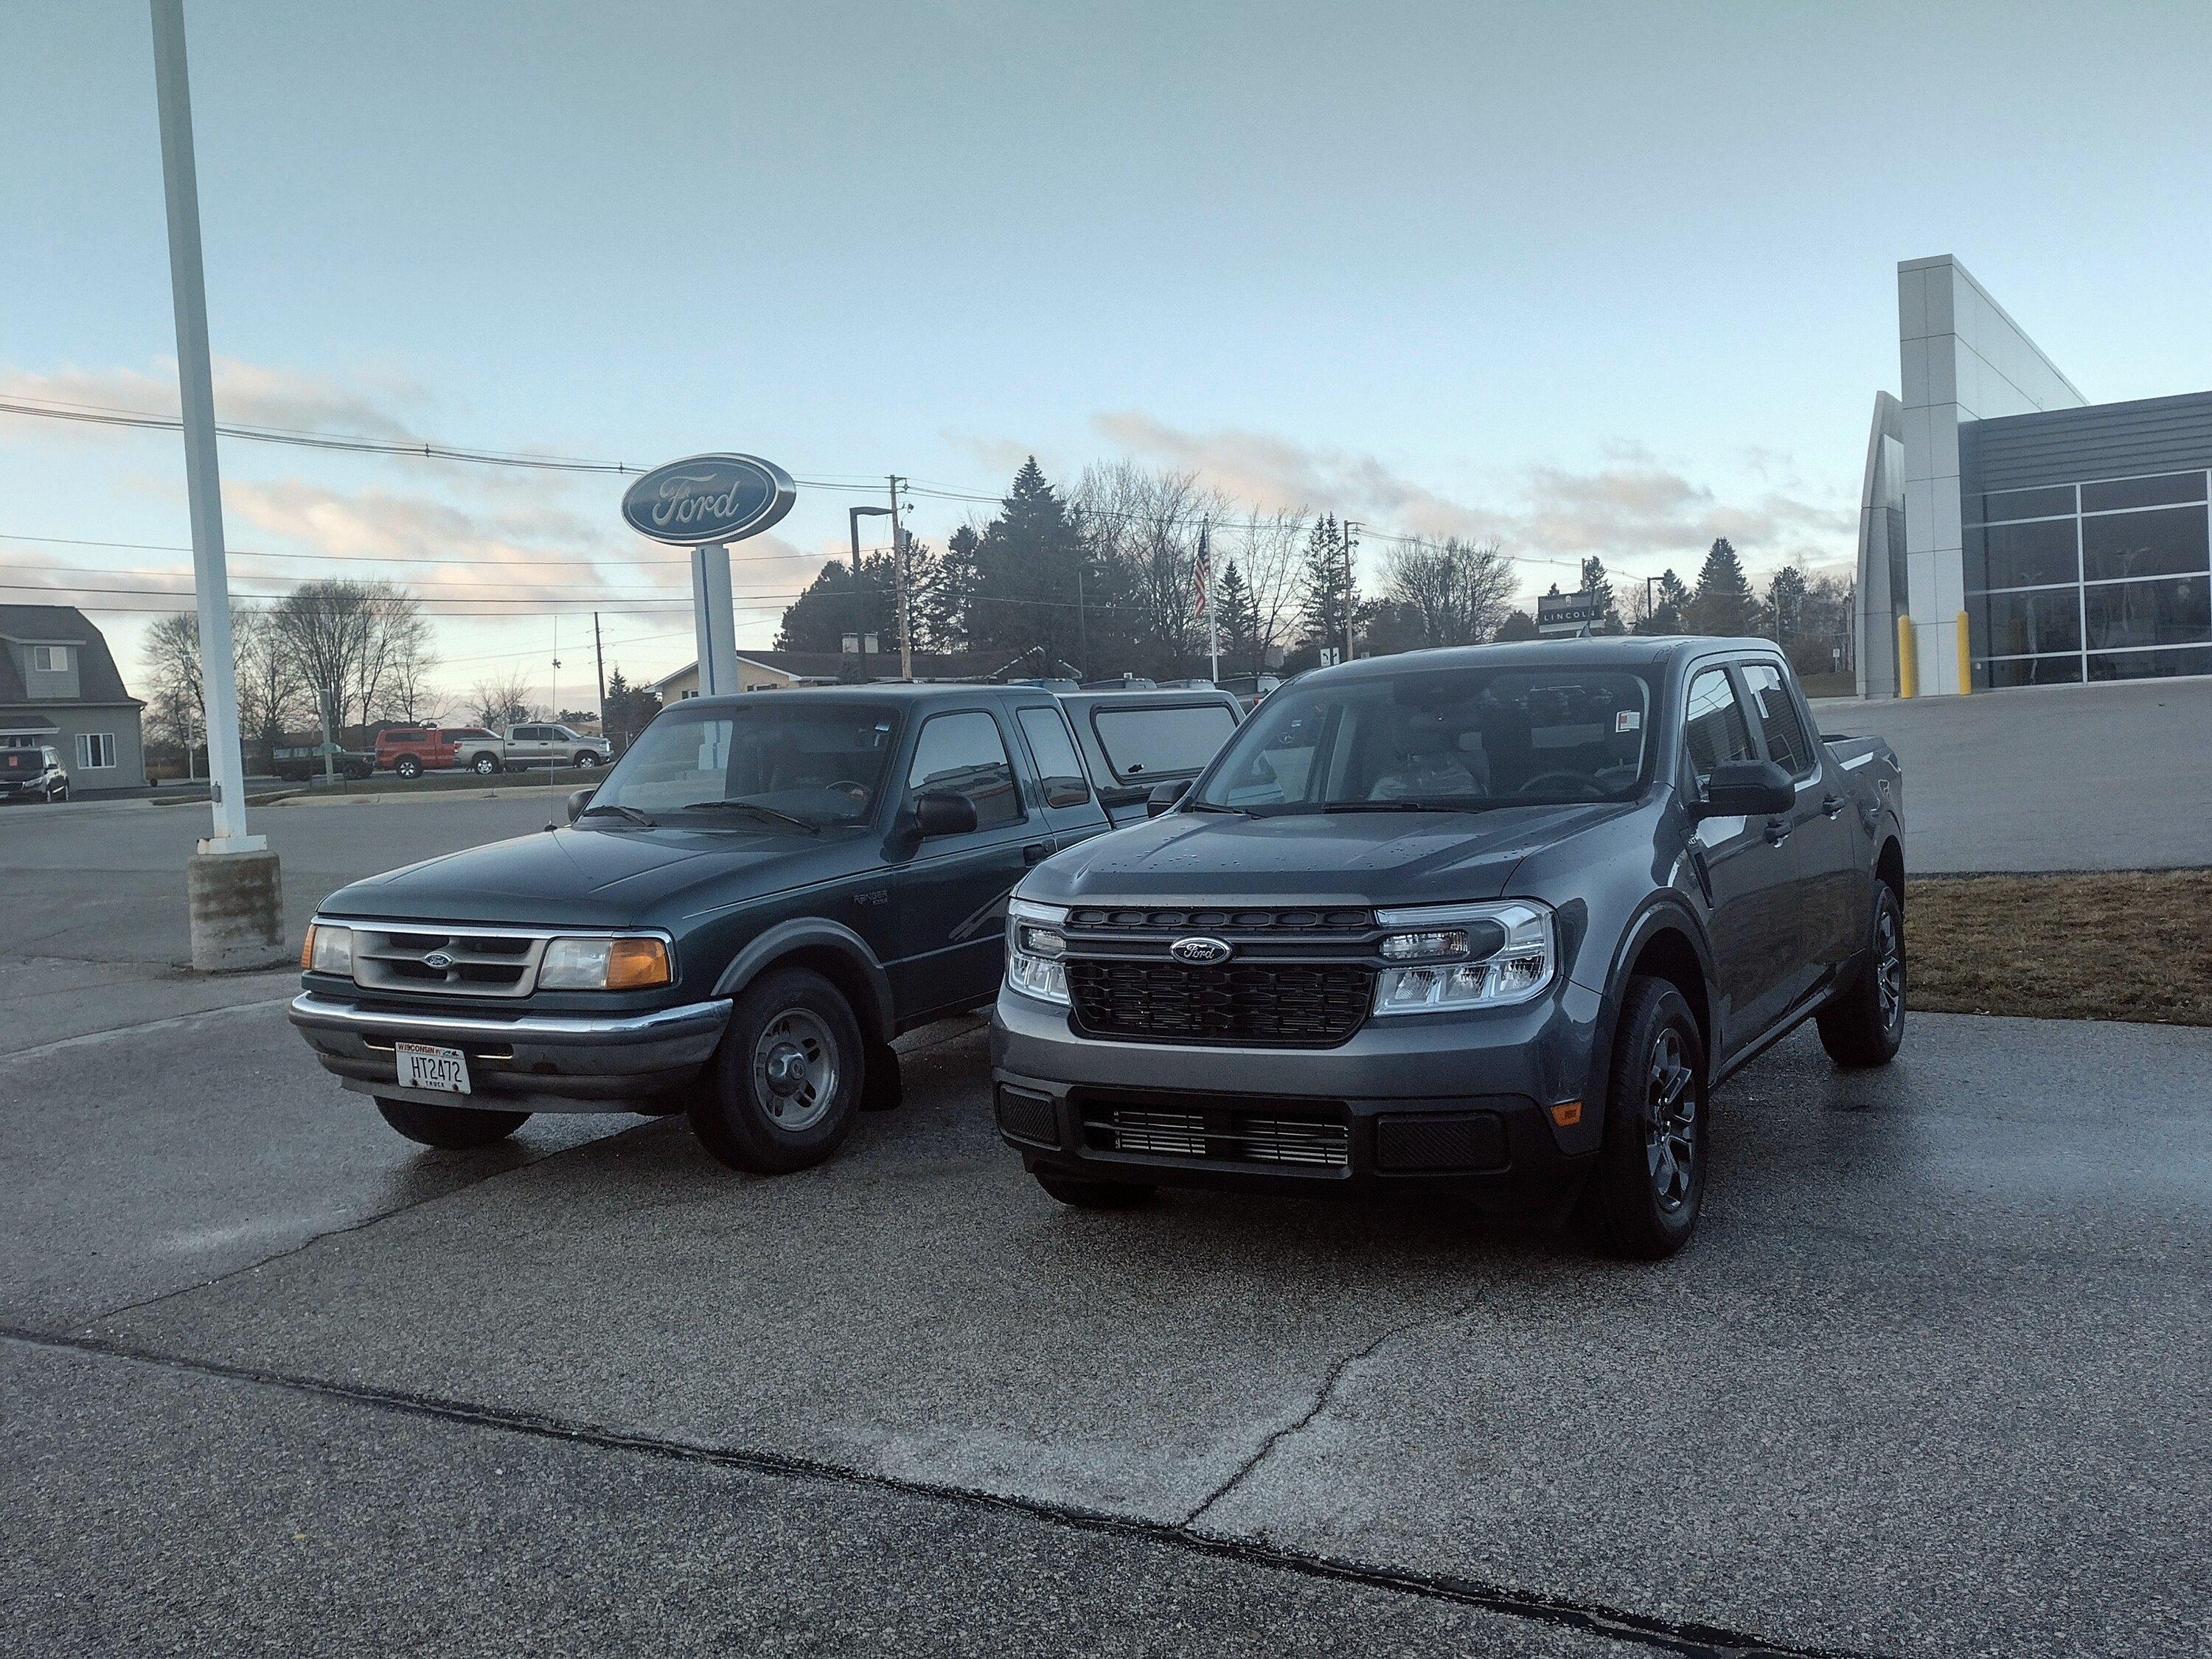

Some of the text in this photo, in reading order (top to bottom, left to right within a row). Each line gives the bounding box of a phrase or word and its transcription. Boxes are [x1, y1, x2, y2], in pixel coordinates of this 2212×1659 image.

[652, 473, 740, 526] Ford
[1183, 943, 1215, 959] Ford
[397, 1043, 435, 1054] WISCONSIN
[411, 1057, 462, 1082] HT2472
